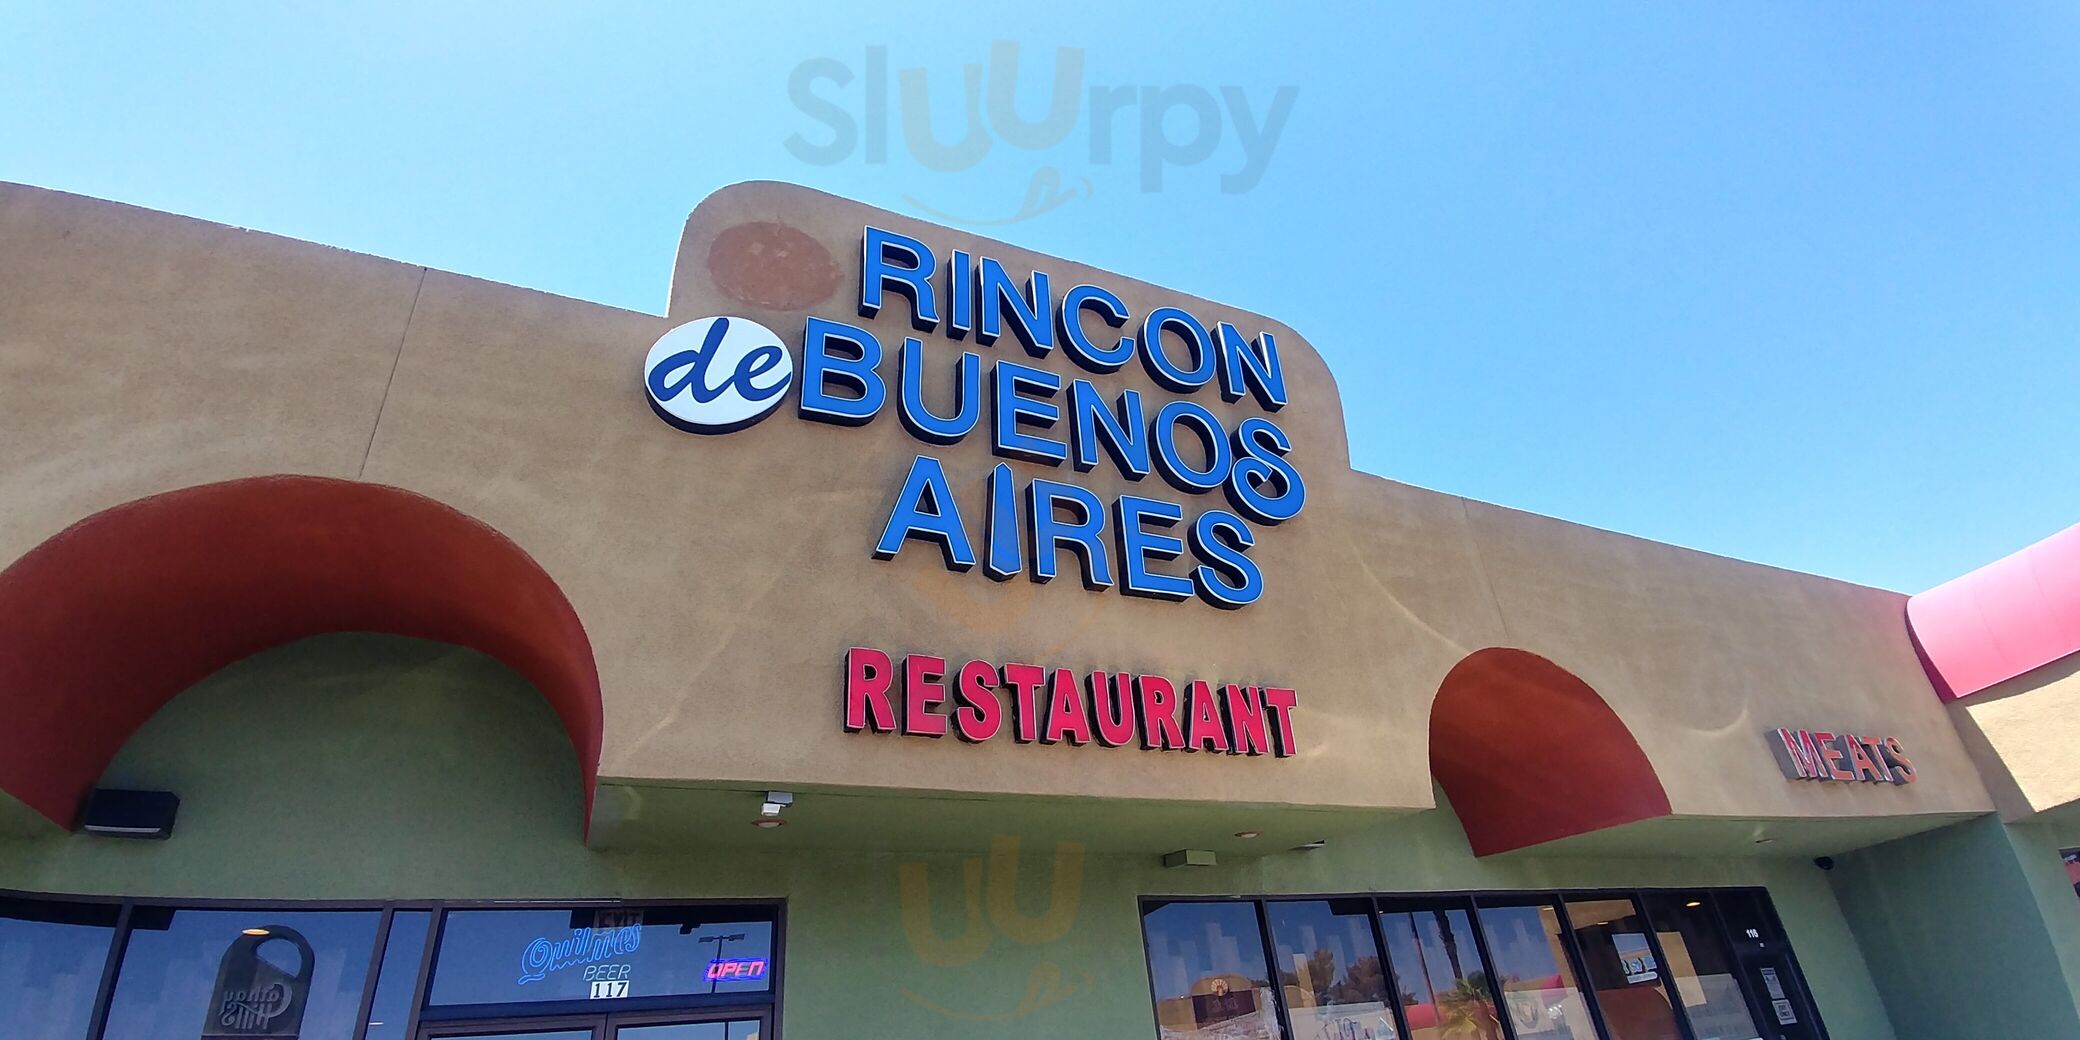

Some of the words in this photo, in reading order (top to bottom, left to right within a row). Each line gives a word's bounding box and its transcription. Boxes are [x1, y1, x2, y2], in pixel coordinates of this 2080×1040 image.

[859, 225, 1289, 412] RINCON
[647, 317, 793, 402] de
[799, 316, 1307, 523] BUENOS
[872, 455, 1264, 609] AIRES
[844, 646, 1298, 757] RESTAURANT
[1770, 727, 1918, 785] MEATS
[582, 964, 632, 982] BEER
[593, 982, 628, 998] 117
[706, 961, 765, 979] OPEN
